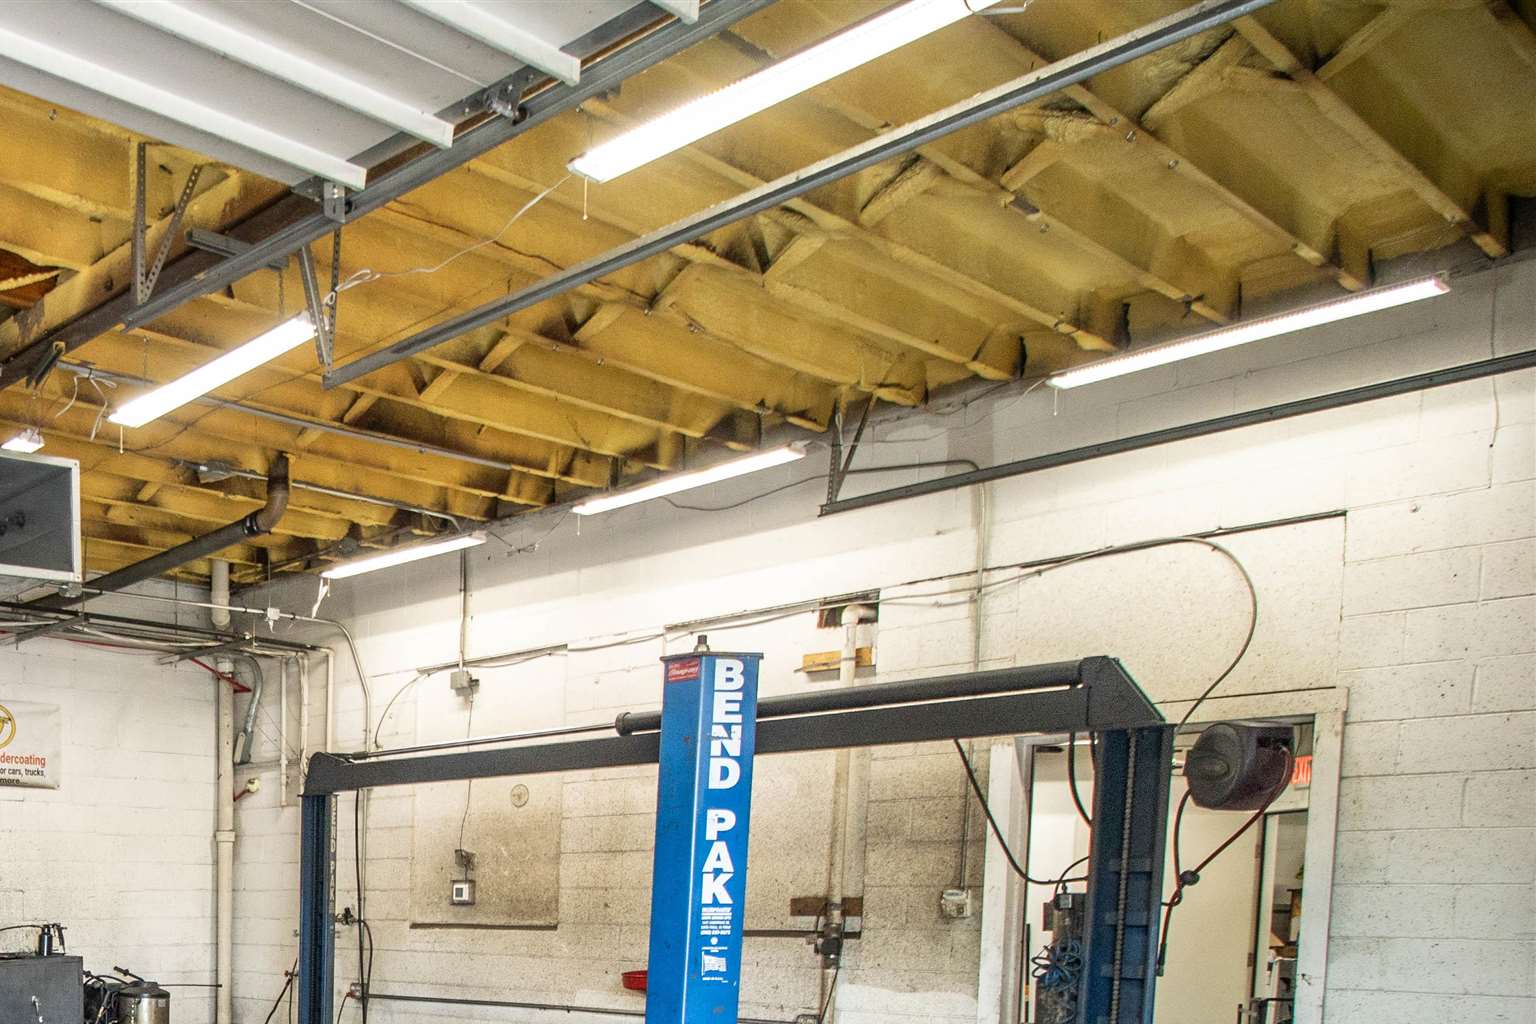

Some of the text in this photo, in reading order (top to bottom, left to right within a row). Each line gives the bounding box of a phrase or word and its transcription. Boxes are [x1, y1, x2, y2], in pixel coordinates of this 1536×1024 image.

[708, 658, 745, 790] BEND
[7, 768, 23, 778] cars,
[701, 808, 737, 905] PAK
